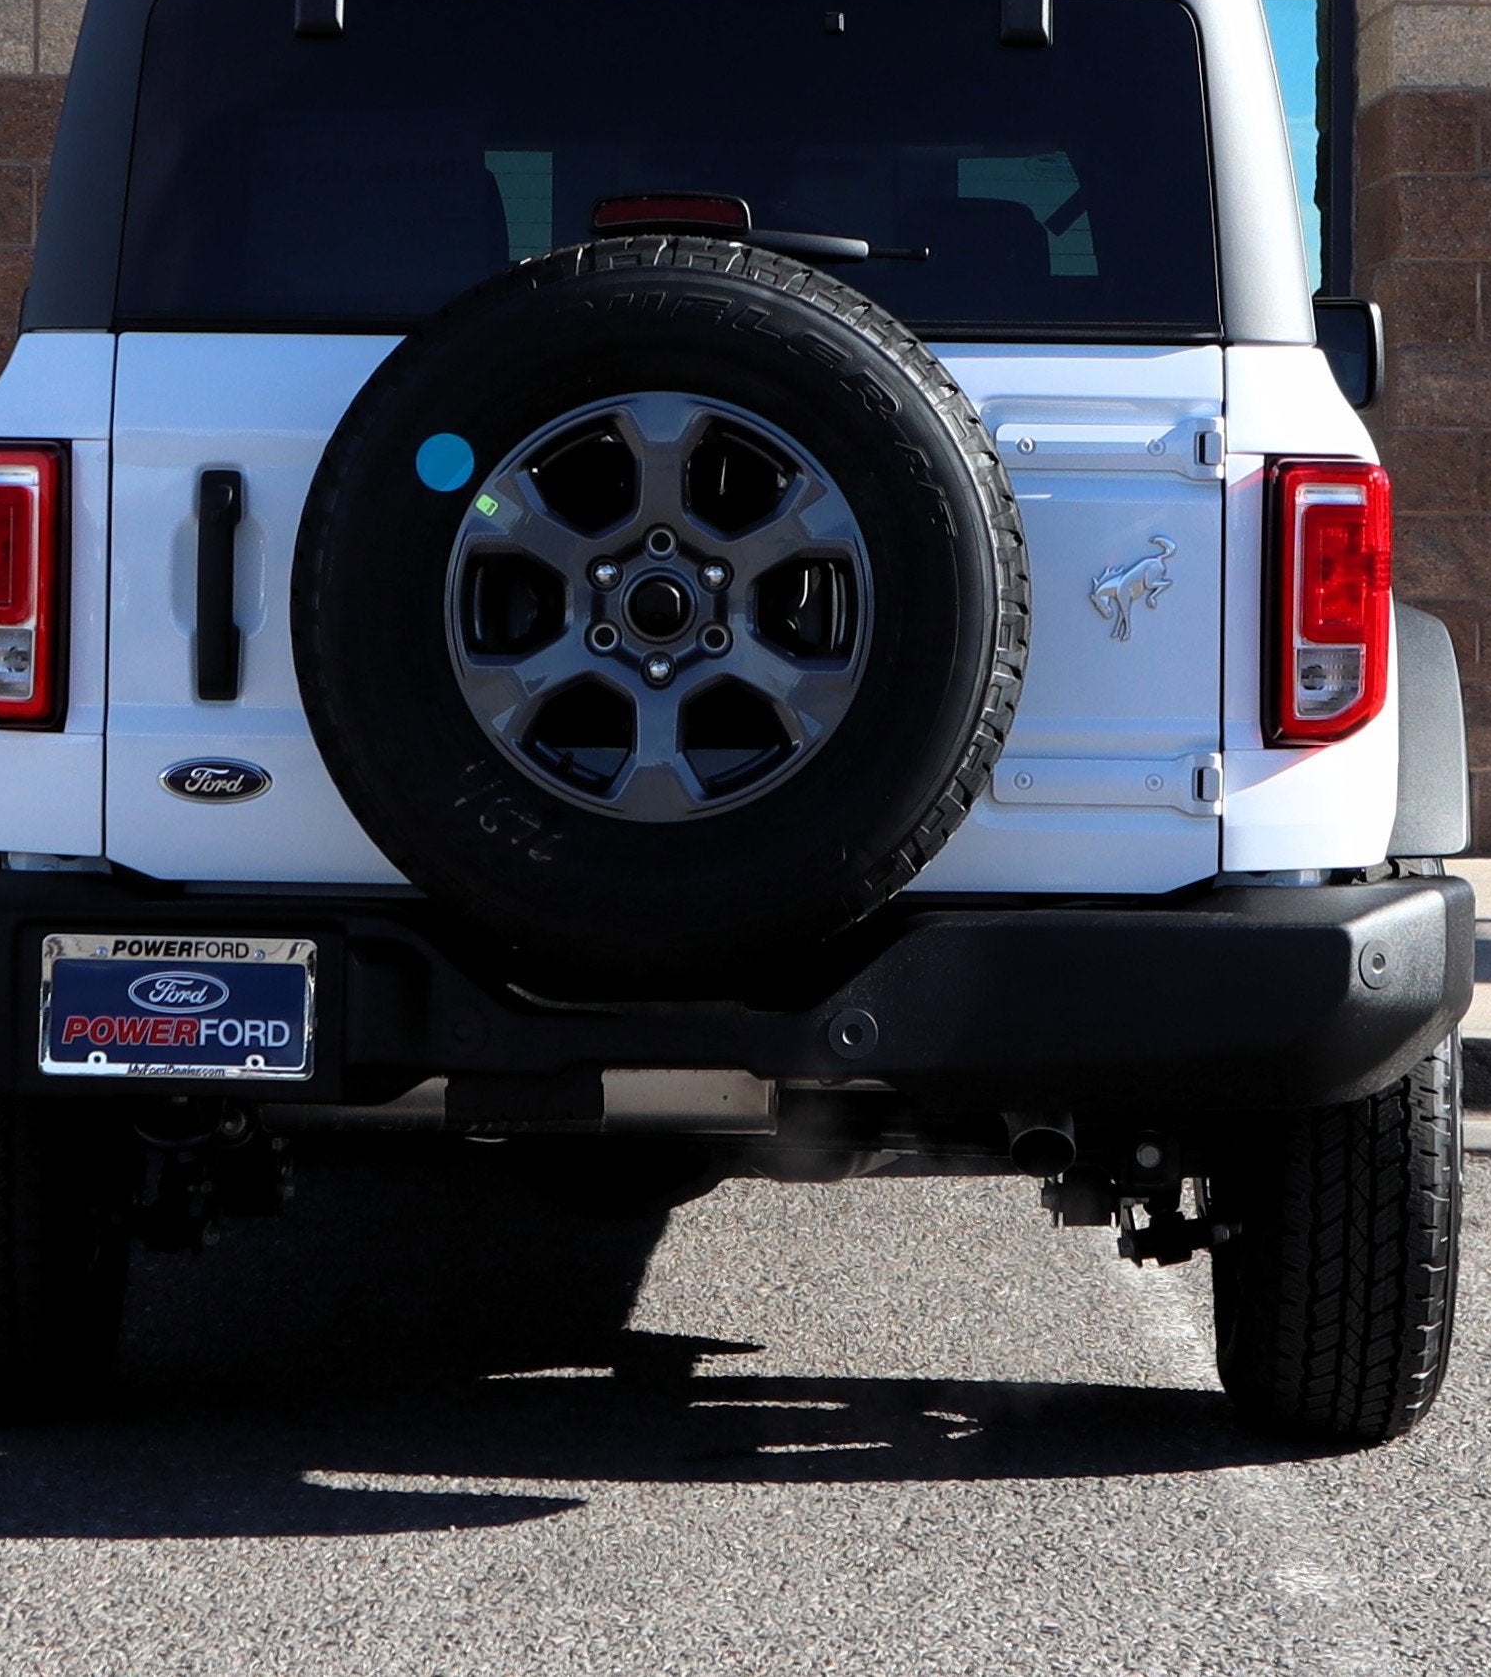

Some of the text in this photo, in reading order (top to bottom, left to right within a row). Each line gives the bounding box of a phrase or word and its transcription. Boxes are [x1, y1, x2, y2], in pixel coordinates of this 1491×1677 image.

[557, 290, 903, 421] UELER
[184, 766, 245, 793] Ford
[112, 939, 250, 959] POWERFORD
[148, 978, 209, 1005] Ford
[62, 1016, 291, 1048] POWERFORD
